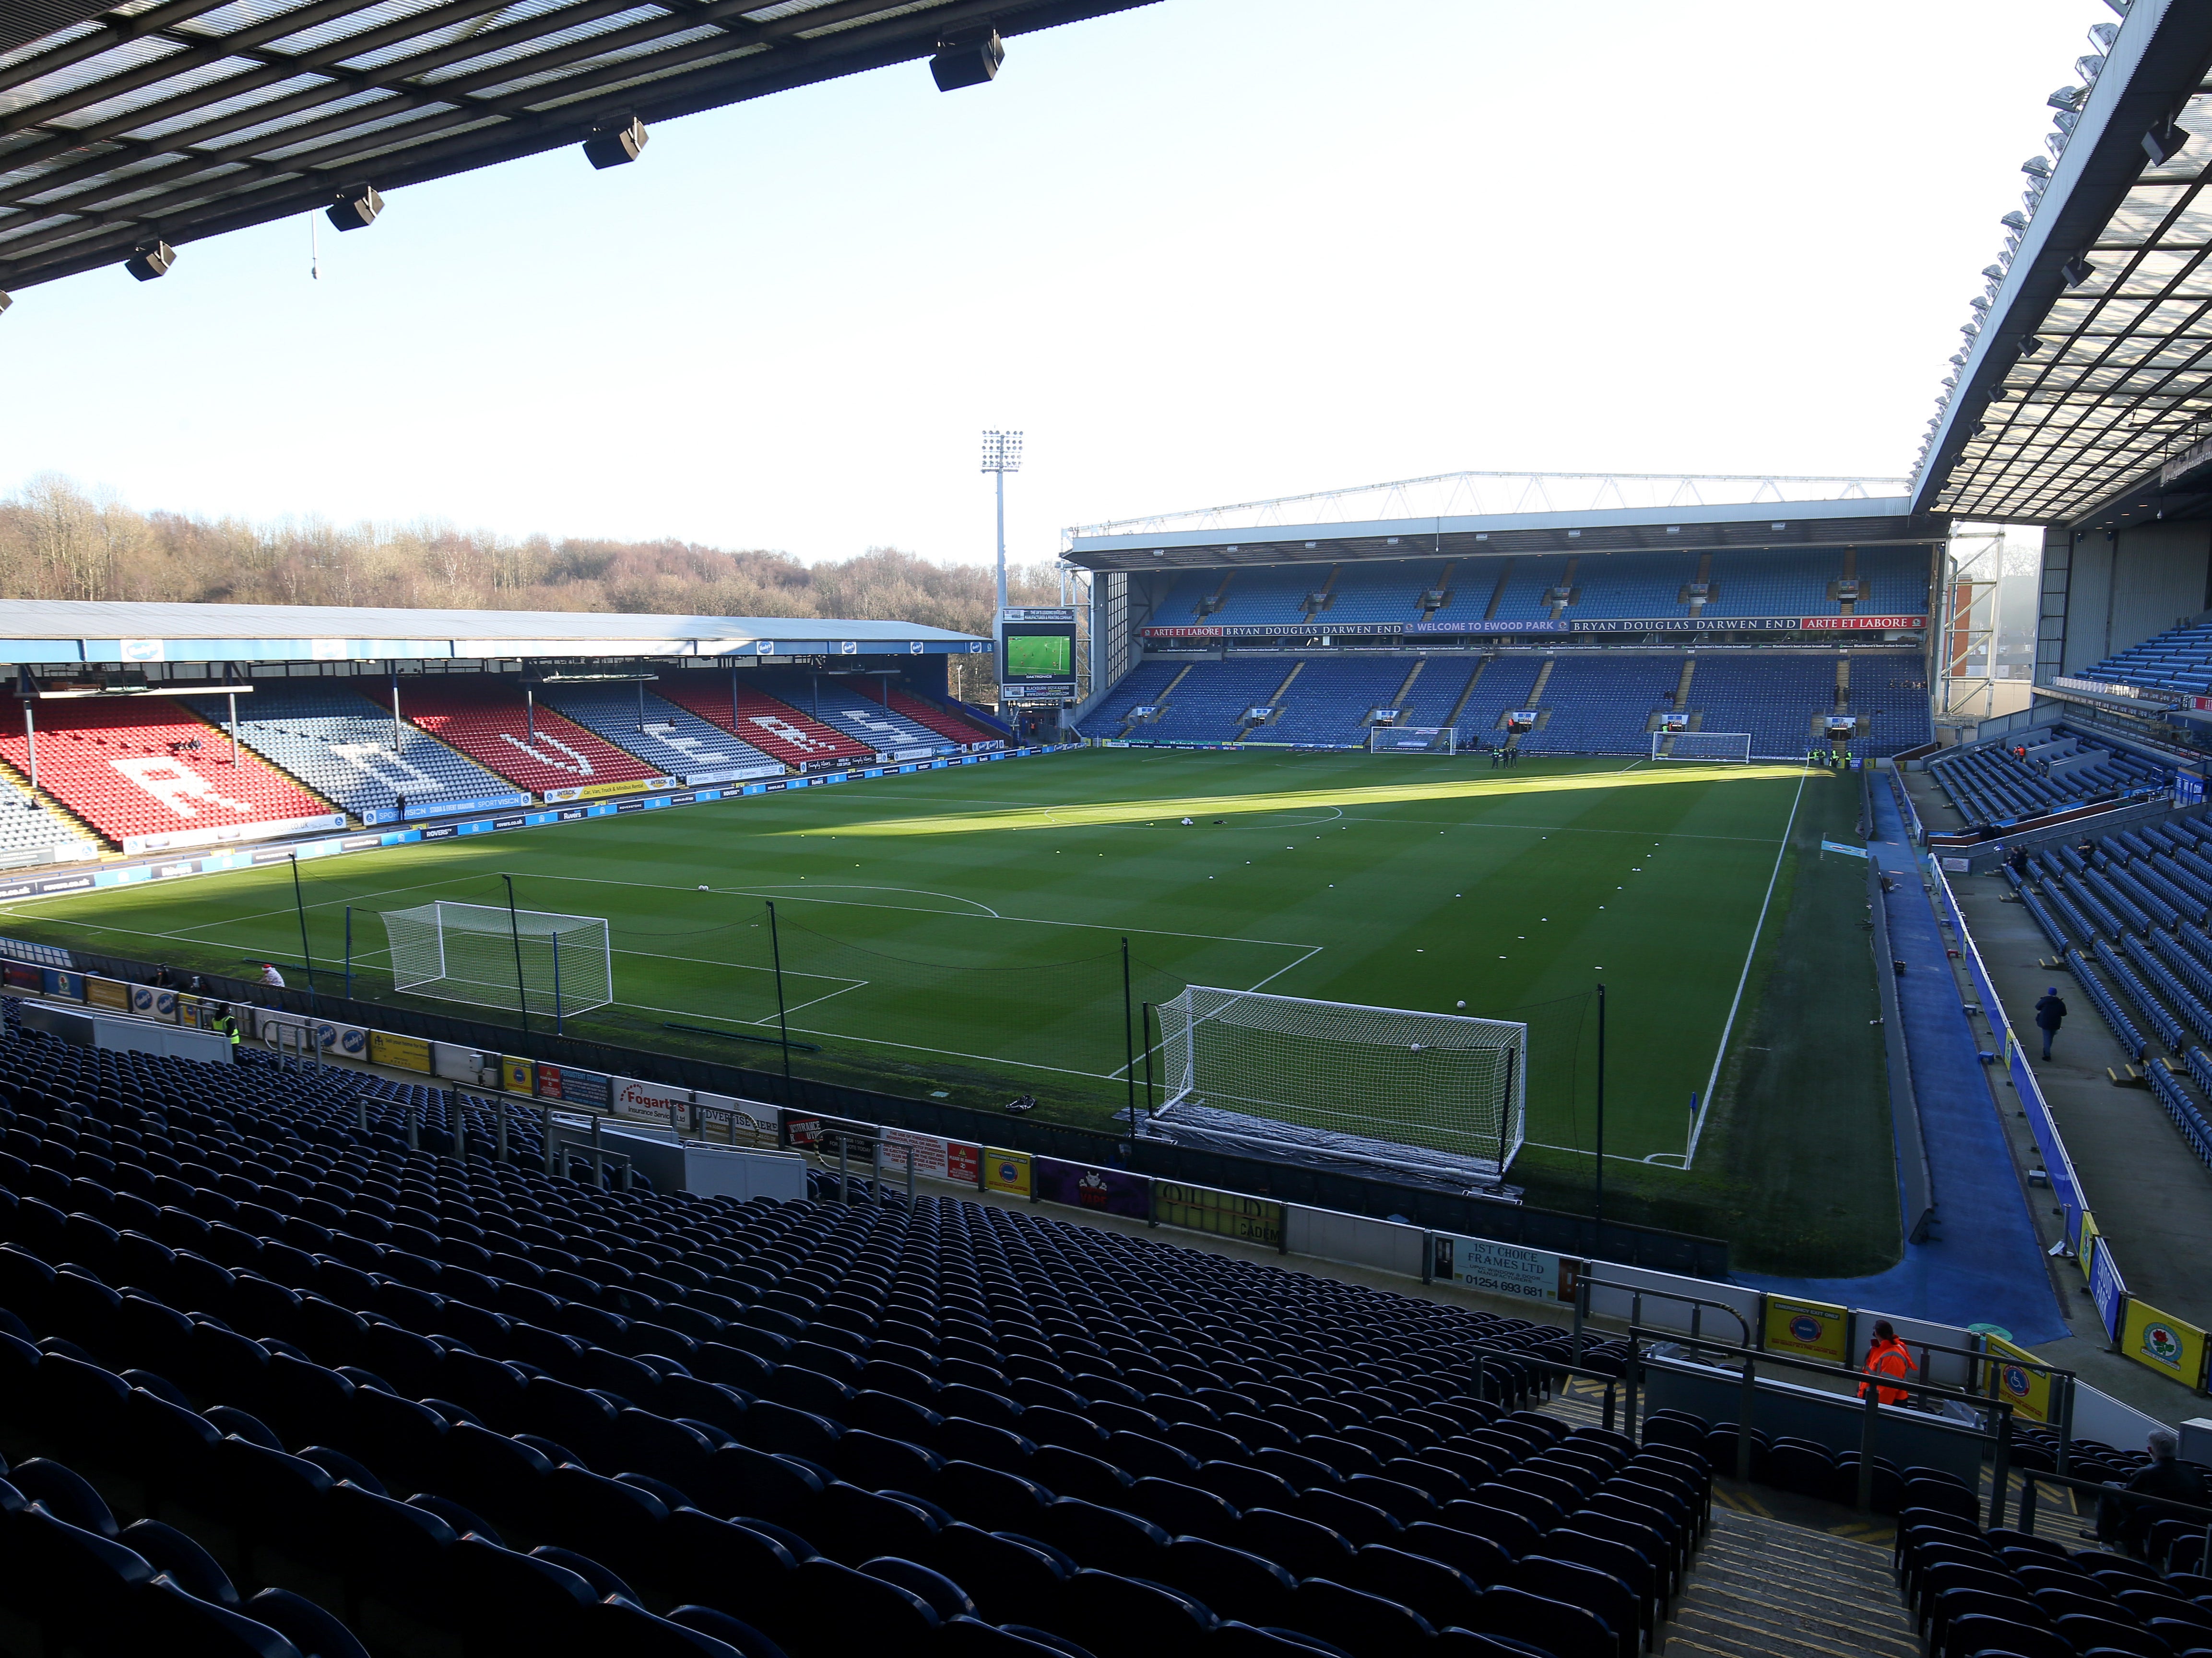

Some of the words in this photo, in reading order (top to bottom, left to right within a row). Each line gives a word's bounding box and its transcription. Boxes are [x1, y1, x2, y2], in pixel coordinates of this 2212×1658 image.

[1417, 623, 1465, 631] WELCOME
[1468, 622, 1481, 630] TO
[1484, 622, 1523, 630] EWOOD
[1526, 621, 1554, 629] PARK
[1574, 622, 1616, 630] BRYAN
[1624, 621, 1689, 630] DOUGLAS
[1697, 620, 1758, 629] DARWEN
[1765, 620, 1796, 628] END
[1807, 619, 1837, 628] ARTE
[1841, 619, 1856, 628] ET
[1859, 618, 1907, 628] LABORE
[1188, 628, 1219, 636] LABORE
[1265, 627, 1317, 635] DOUGLAS
[1323, 626, 1371, 634] DARWEN
[1377, 625, 1401, 633] END
[808, 761, 820, 770] Simply
[497, 819, 523, 828] rovers.co.uk
[43, 878, 90, 891] rovers.co.uk
[135, 993, 151, 1005] Venky's
[343, 1033, 363, 1049] Venky's
[628, 1106, 653, 1116] Insurance
[912, 1135, 938, 1144] THREATENING
[1474, 1243, 1495, 1255] 1ST
[1498, 1246, 1538, 1263] CHOICE
[1468, 1253, 1518, 1270] FRAMES
[1522, 1262, 1544, 1274] LTD
[1478, 1270, 1532, 1283] MANUFACTURERS
[1487, 1268, 1514, 1276] WINDOW
[2098, 1254, 2113, 1300] EWOOD
[1466, 1274, 1499, 1290] 01254
[1501, 1281, 1521, 1294] 693
[1523, 1286, 1543, 1298] 681
[2096, 1279, 2108, 1320] PARK
[1775, 1303, 1809, 1314] EMERGENCY
[2142, 1350, 2154, 1359] ARTE
[2161, 1358, 2179, 1370] LABORE
